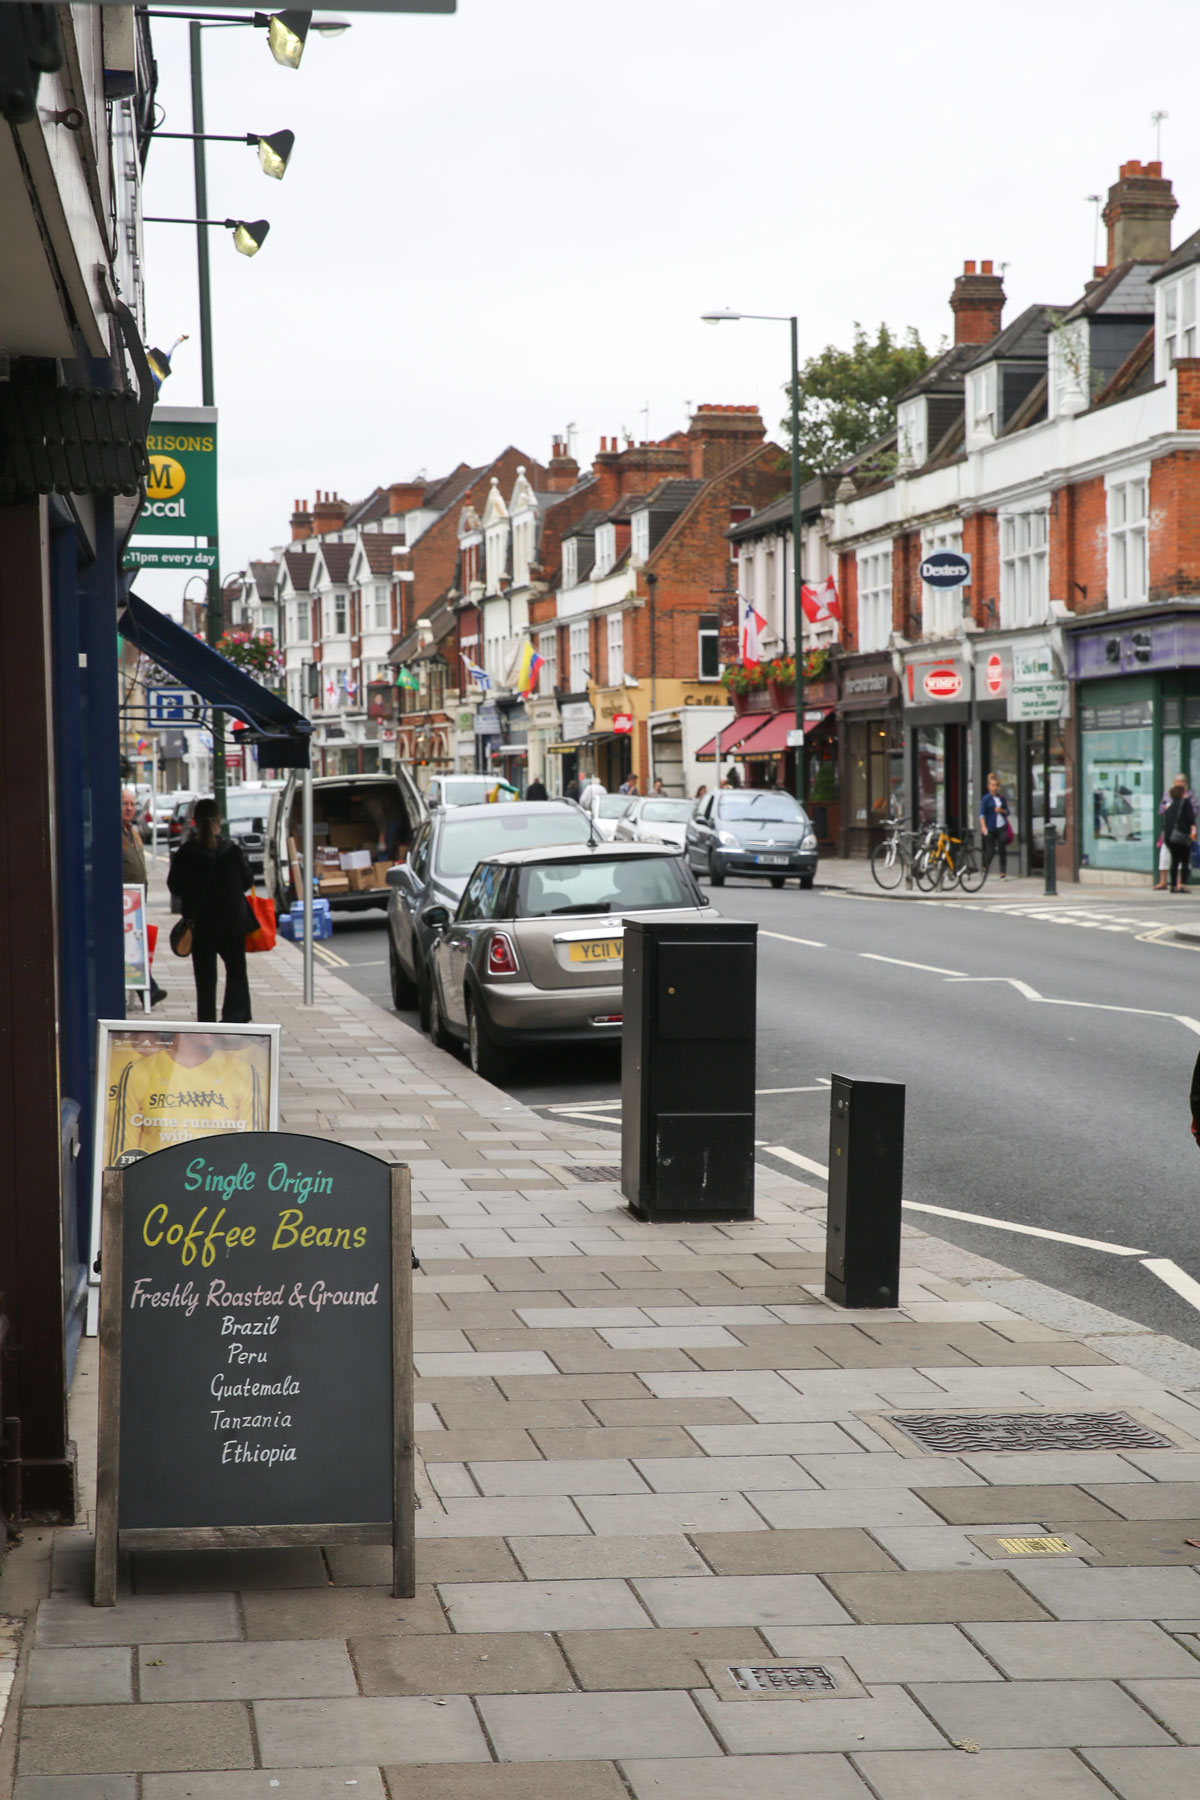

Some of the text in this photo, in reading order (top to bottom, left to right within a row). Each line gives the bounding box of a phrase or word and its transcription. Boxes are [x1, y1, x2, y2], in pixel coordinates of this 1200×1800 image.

[146, 435, 213, 452] RISONS
[147, 463, 174, 489] M
[141, 498, 186, 517] ocal
[122, 551, 215, 566] -11pm every day
[922, 563, 967, 577] Dexters
[926, 677, 960, 690] WIMPY
[1012, 684, 1068, 693] CHINESE FOOD
[149, 1093, 176, 1107] SRC
[130, 1114, 248, 1132] Come running
[159, 1128, 194, 1143] with
[184, 1157, 334, 1204] Single Origin
[142, 1203, 367, 1268] Coffee Beans
[130, 1278, 200, 1316] Freshly
[206, 1278, 285, 1307] Roasted
[308, 1280, 379, 1312] Ground
[220, 1315, 280, 1336] Brazil
[227, 1342, 268, 1365] Peru
[210, 1373, 300, 1401] Guatemala
[210, 1410, 293, 1430] Tanzania
[221, 1440, 297, 1467] Ethiopia
